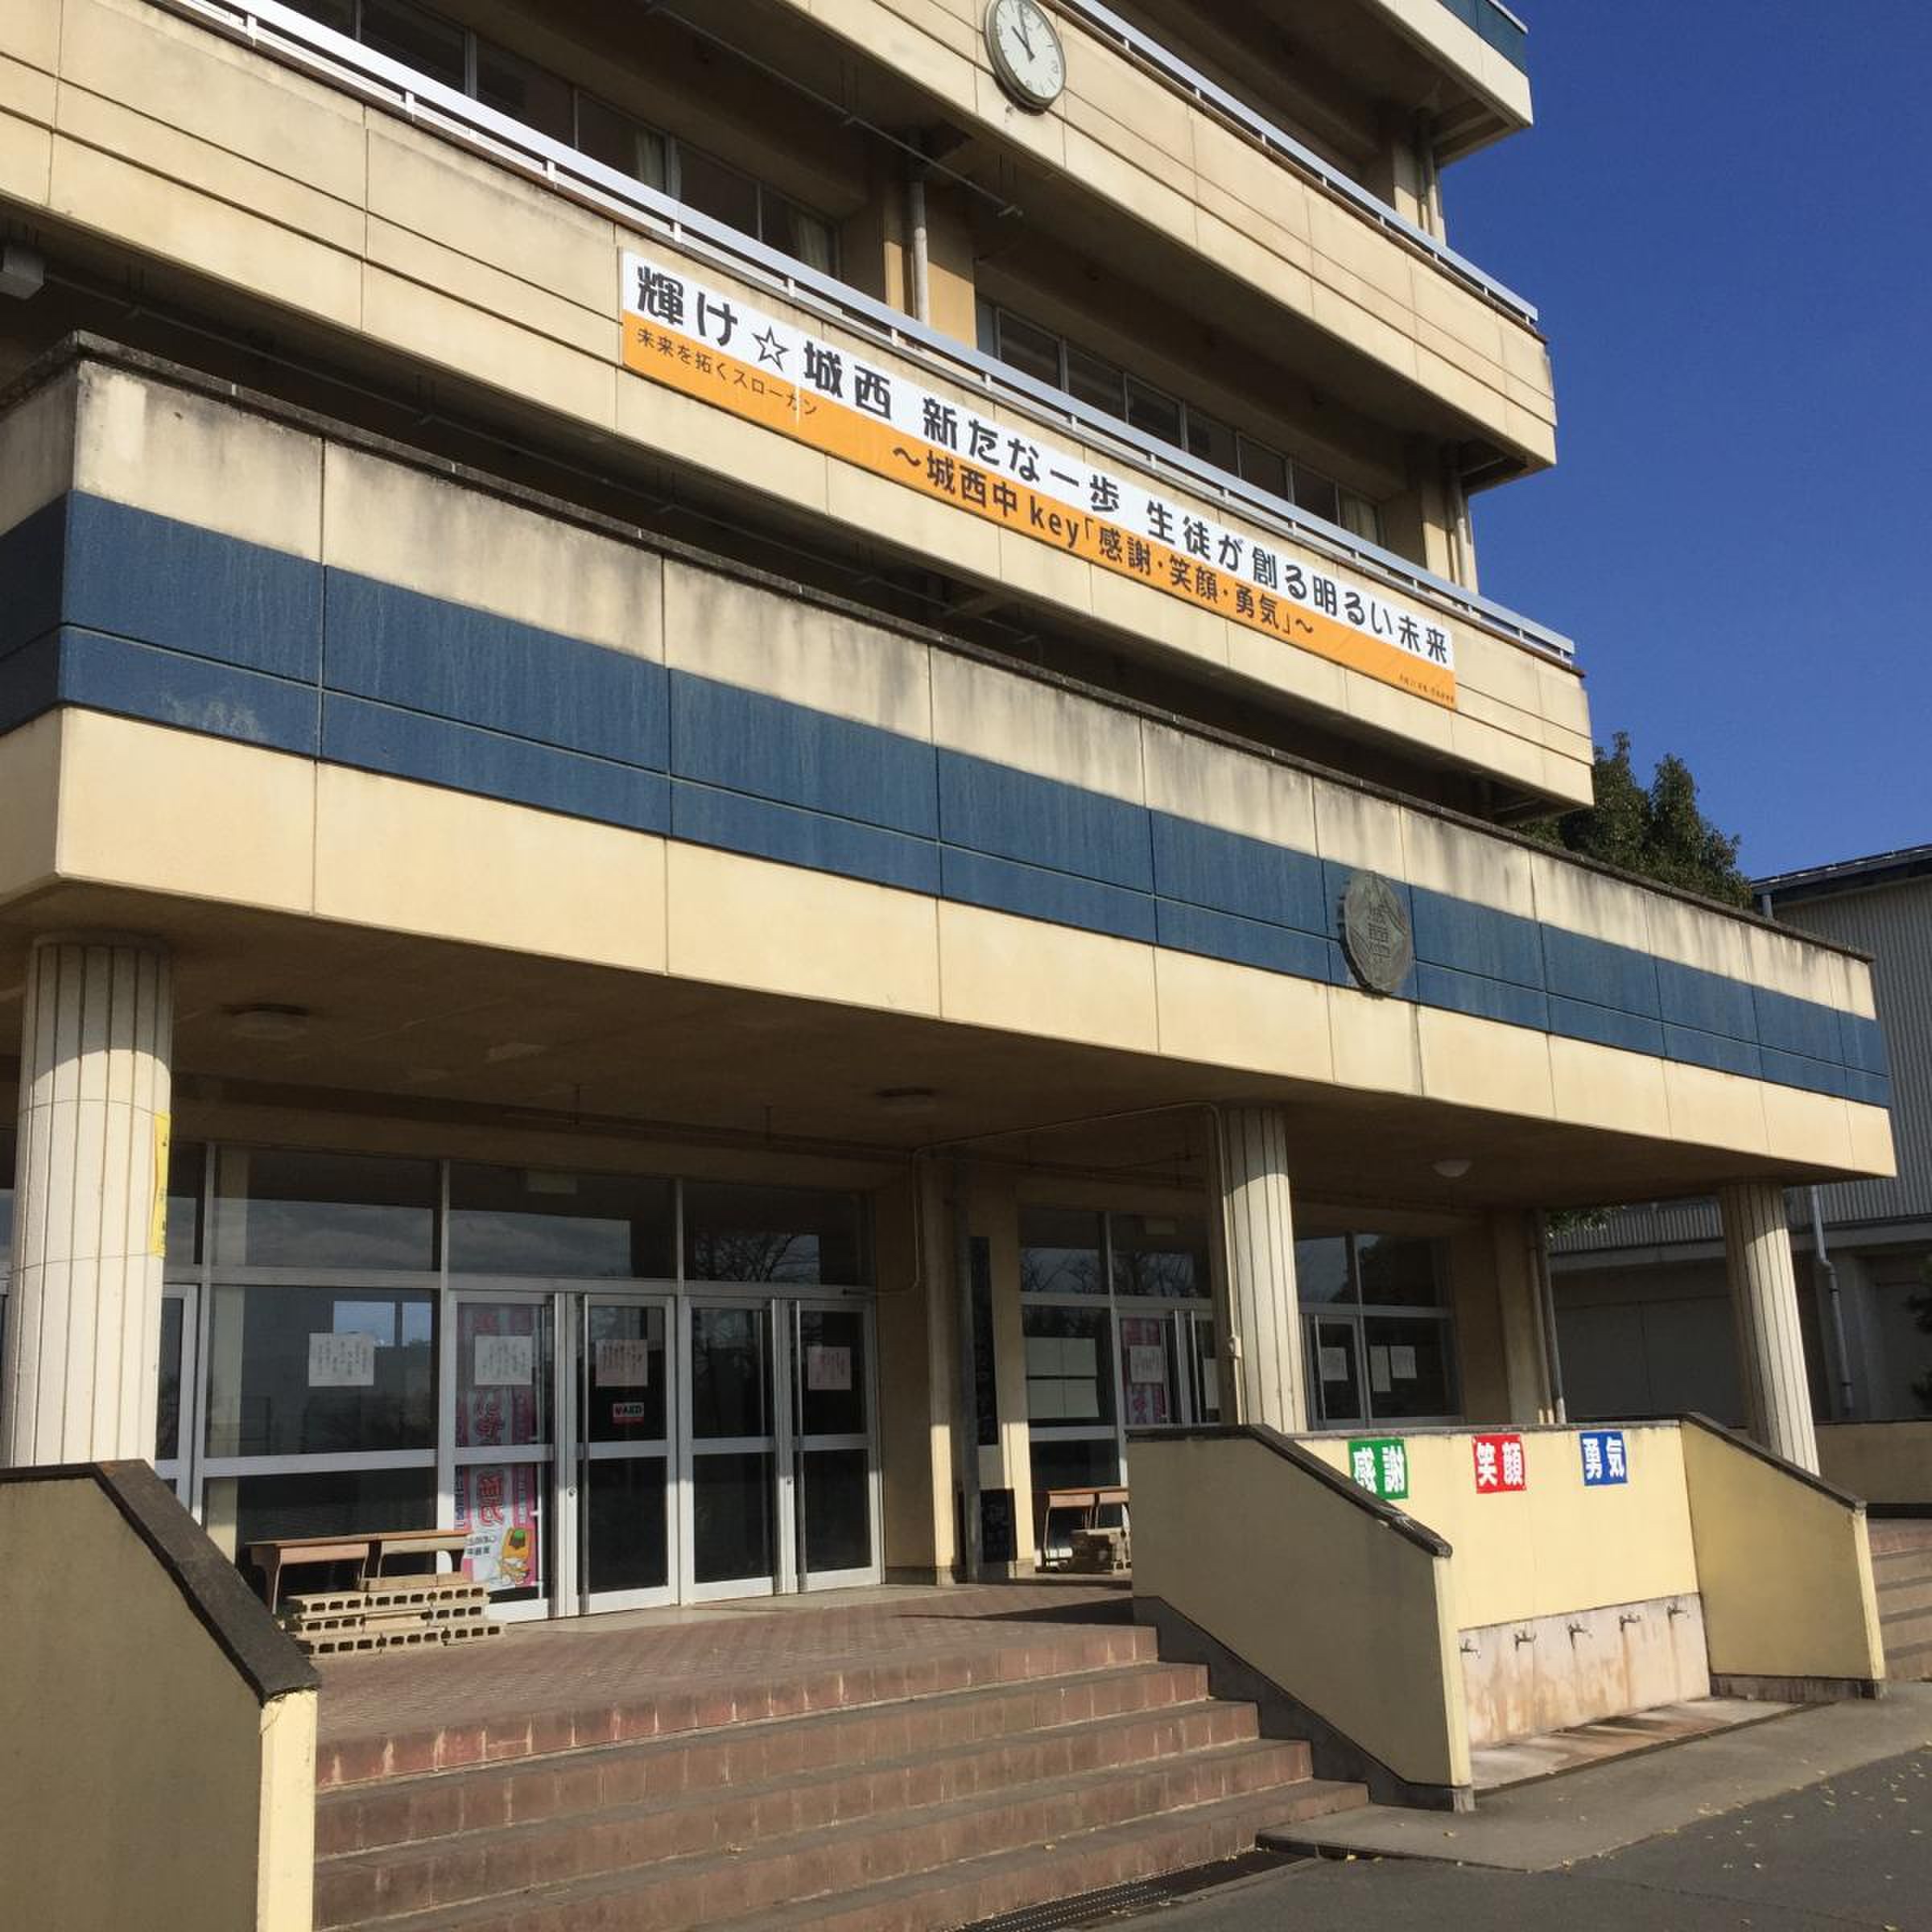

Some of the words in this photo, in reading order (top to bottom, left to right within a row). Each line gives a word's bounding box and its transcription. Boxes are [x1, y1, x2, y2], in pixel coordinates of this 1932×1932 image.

[923, 397, 1120, 513] 新たな一歩
[1146, 499, 1447, 663] 生徒が創る明るい未来
[1352, 1446, 1405, 1494] 感謝
[1476, 1442, 1523, 1487] 笑顔
[1583, 1436, 1624, 1480] 勇気
